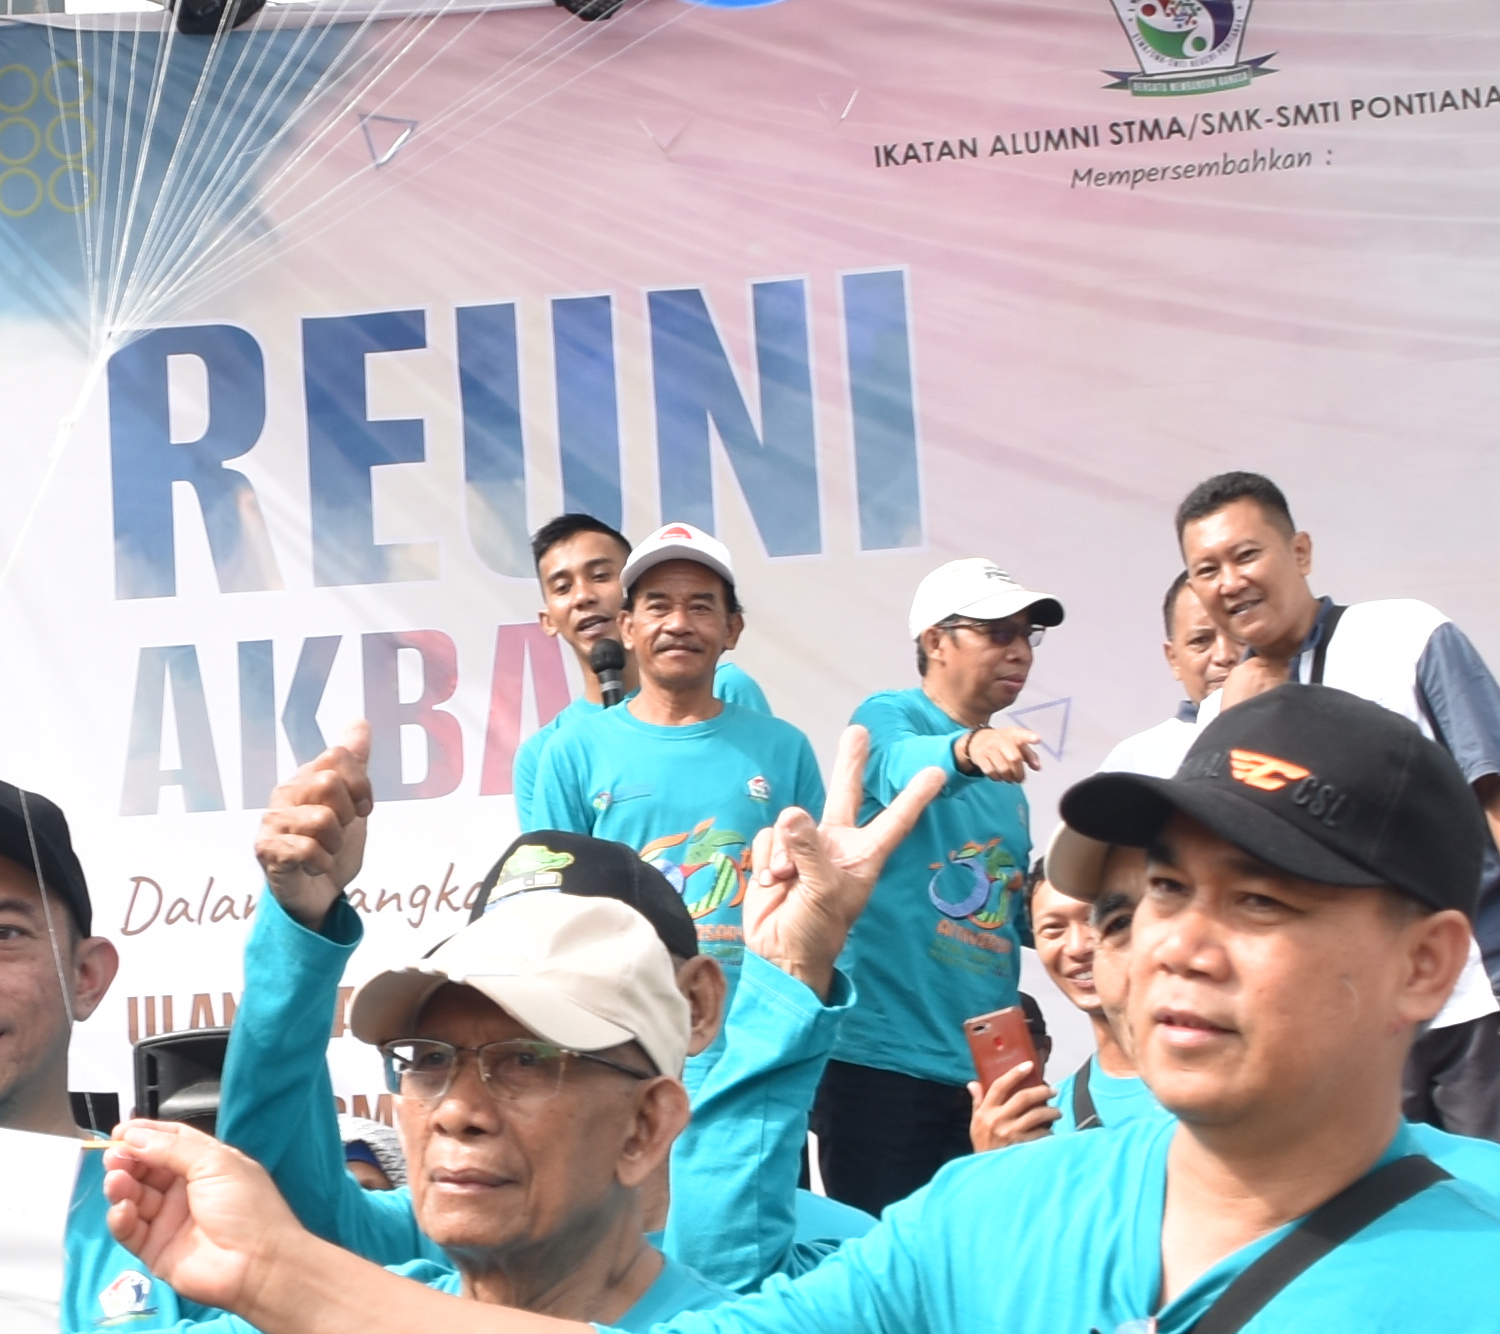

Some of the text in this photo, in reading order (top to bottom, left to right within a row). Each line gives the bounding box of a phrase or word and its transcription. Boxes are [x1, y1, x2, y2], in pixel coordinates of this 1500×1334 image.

[874, 137, 979, 168] IKATAN
[988, 124, 1101, 158] ALUMNI
[1109, 101, 1340, 146] STMA/SMK-SMTI
[1070, 147, 1312, 191] Mempersembahkan
[104, 269, 922, 603] REUNI
[118, 622, 574, 820] AKBA
